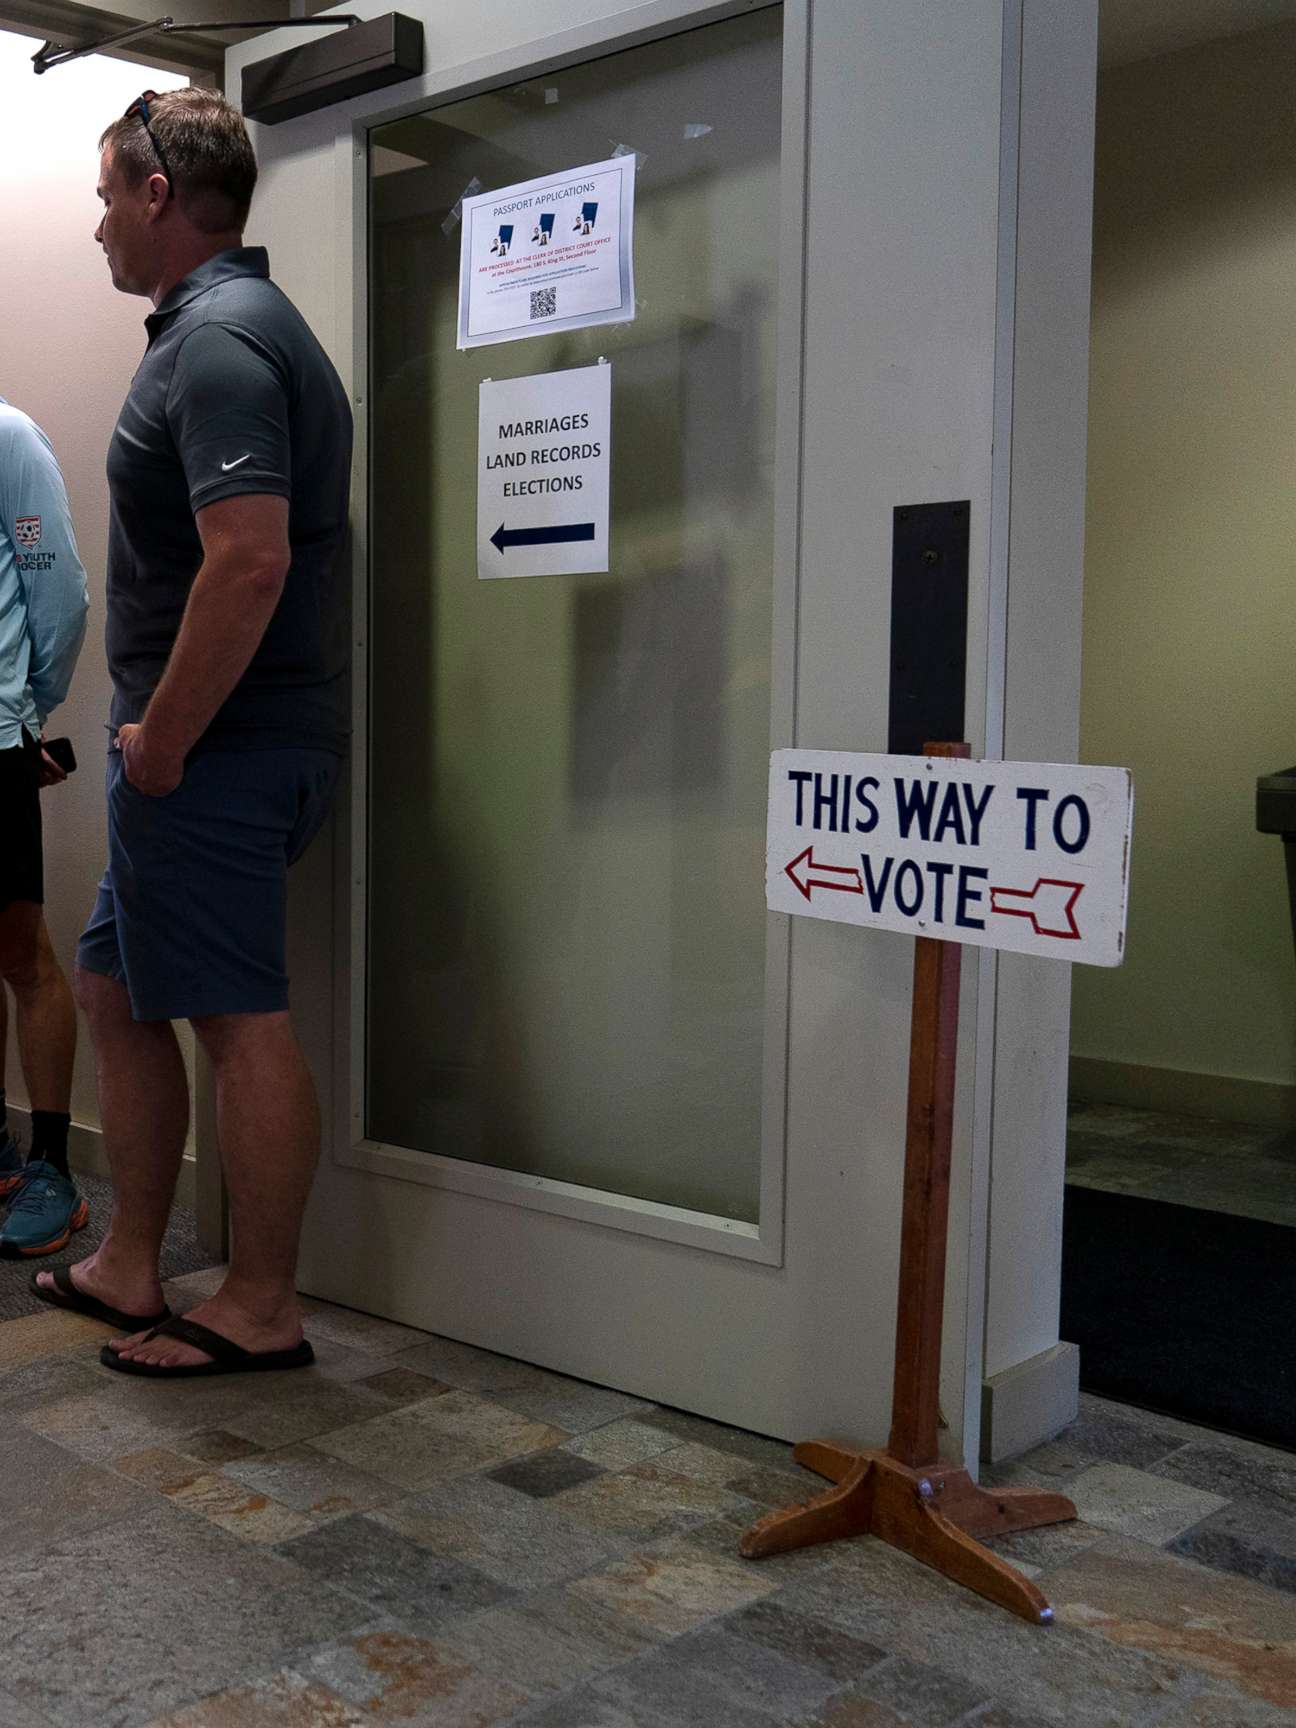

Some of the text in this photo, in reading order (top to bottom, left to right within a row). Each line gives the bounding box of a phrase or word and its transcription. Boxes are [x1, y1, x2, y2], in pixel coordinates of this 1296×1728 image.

[493, 182, 596, 217] PASSPORT APPLICATIONS
[498, 413, 589, 439] MARRIAGES
[486, 442, 602, 470] LAND RECORDS
[504, 475, 583, 497] ELECTIONS
[788, 770, 1091, 854] THIS WAY TO
[860, 853, 989, 930] VOTE
